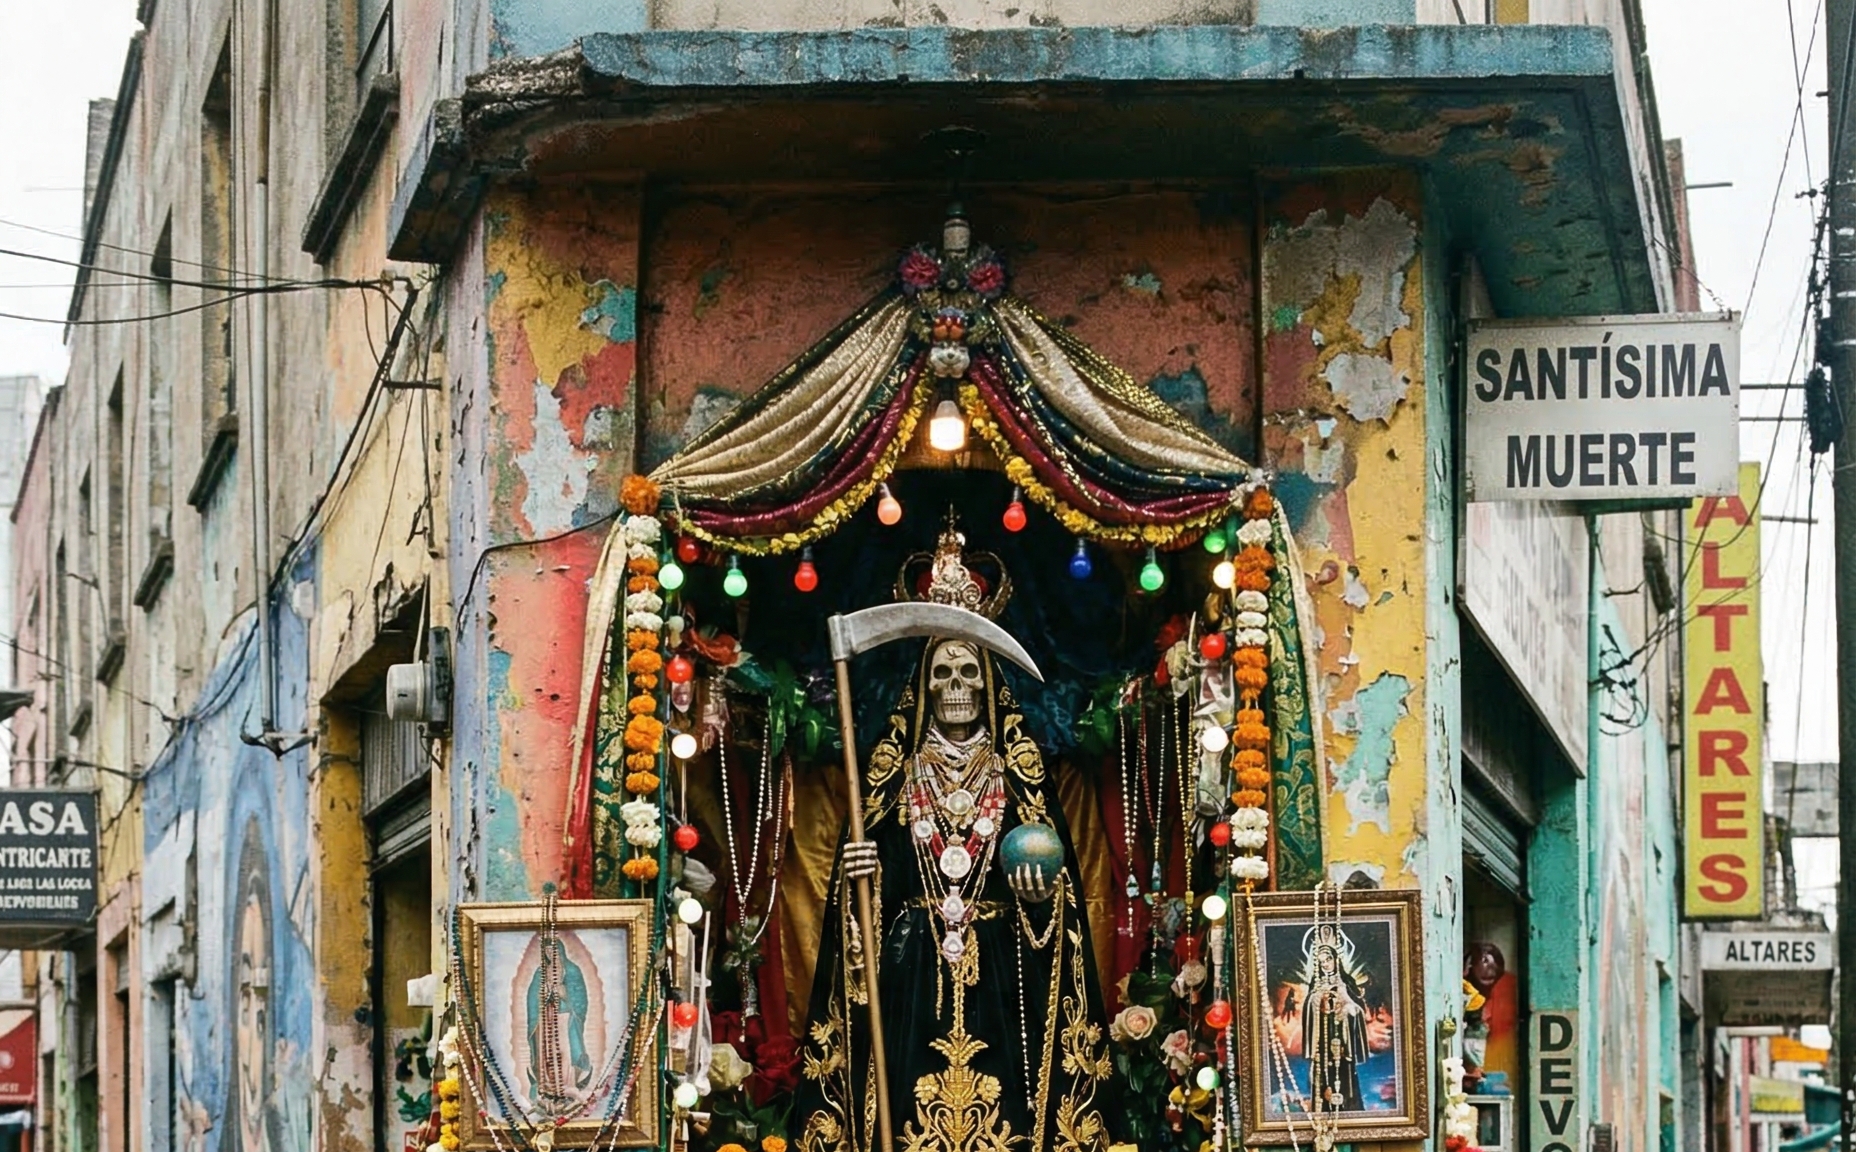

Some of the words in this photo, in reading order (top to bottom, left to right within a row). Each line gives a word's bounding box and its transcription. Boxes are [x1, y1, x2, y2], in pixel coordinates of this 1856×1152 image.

[1475, 332, 1731, 402] SANTÍSIMA
[1506, 432, 1696, 488] MUERTE
[1693, 496, 1753, 904] ALTARES
[1726, 940, 1815, 963] ALTARES
